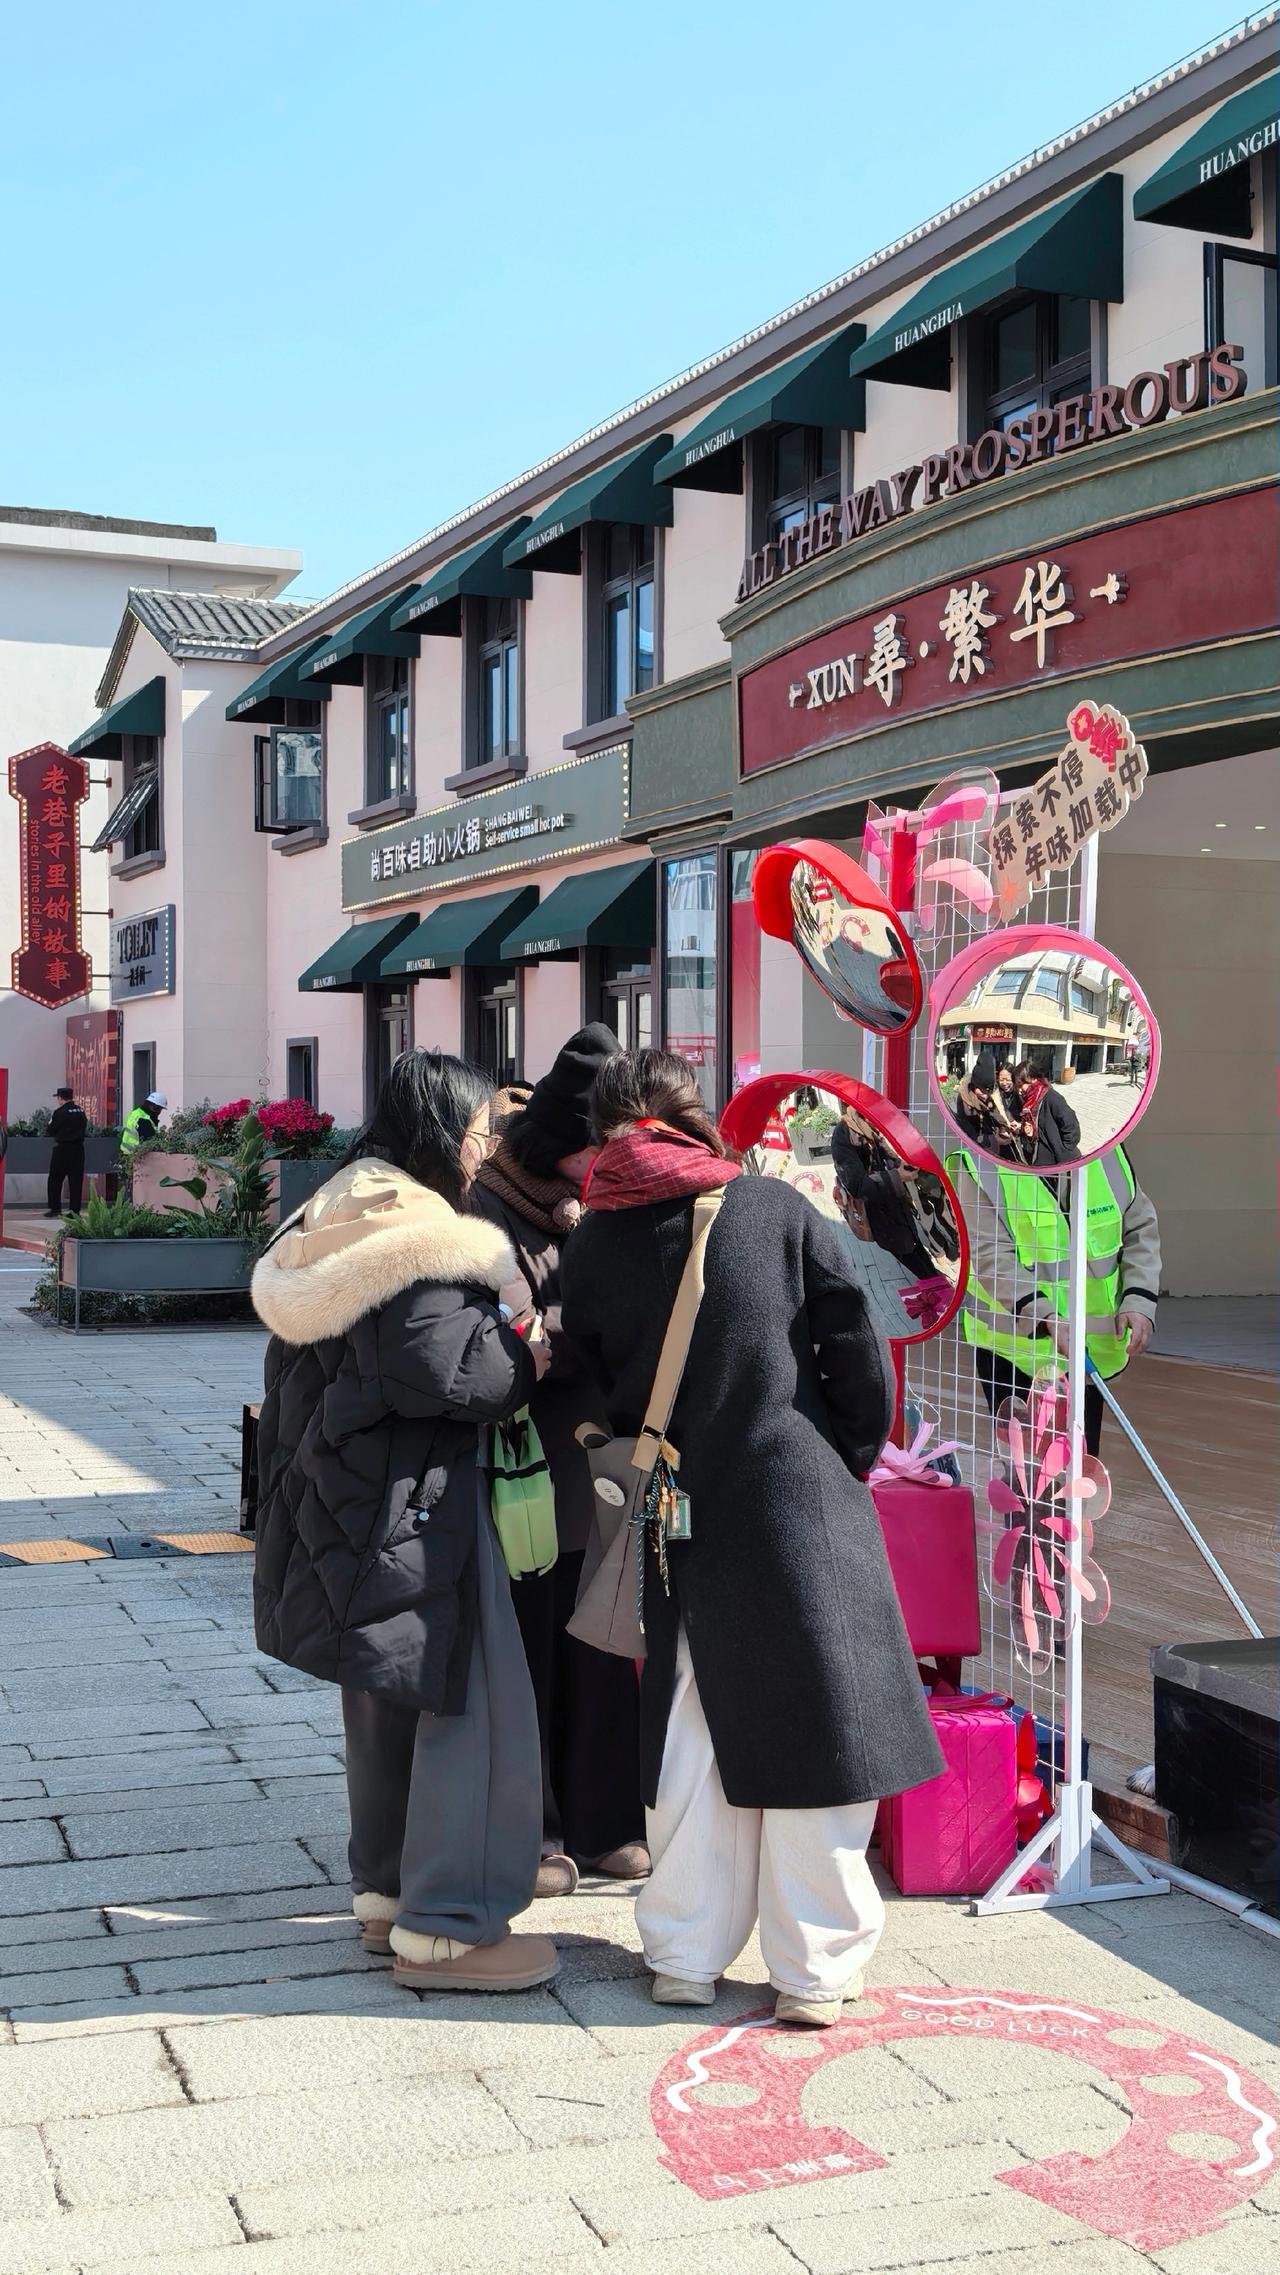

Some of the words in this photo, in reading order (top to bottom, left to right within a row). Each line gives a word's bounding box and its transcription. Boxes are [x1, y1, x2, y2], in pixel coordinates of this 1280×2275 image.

[1200, 119, 1280, 184] HUANGH
[895, 302, 964, 352] HUANGHUA
[685, 427, 735, 467] HUANGHUA
[736, 543, 778, 603] ALL
[779, 505, 842, 575] THE
[842, 466, 922, 538] WAY
[923, 344, 1247, 505] PROSPEROUS
[526, 522, 564, 554] HUANGHUA
[807, 653, 857, 710] XUN
[993, 748, 1084, 870] 探索不停
[1025, 752, 1142, 882] 年味加载中
[30, 820, 40, 857] stories
[485, 825, 520, 847] Self-service
[520, 817, 539, 838] small
[540, 816, 550, 832] hot
[551, 812, 564, 832] pot
[31, 860, 42, 871] in
[31, 874, 42, 893] the
[40, 763, 73, 990] 老巷子里的故事
[31, 897, 42, 914] old
[31, 916, 43, 944] alley
[117, 917, 158, 964] TOILET
[524, 938, 561, 955] HUANGHUA
[901, 2010, 995, 2028] GOOD
[1008, 2020, 1089, 2038] LUCK
